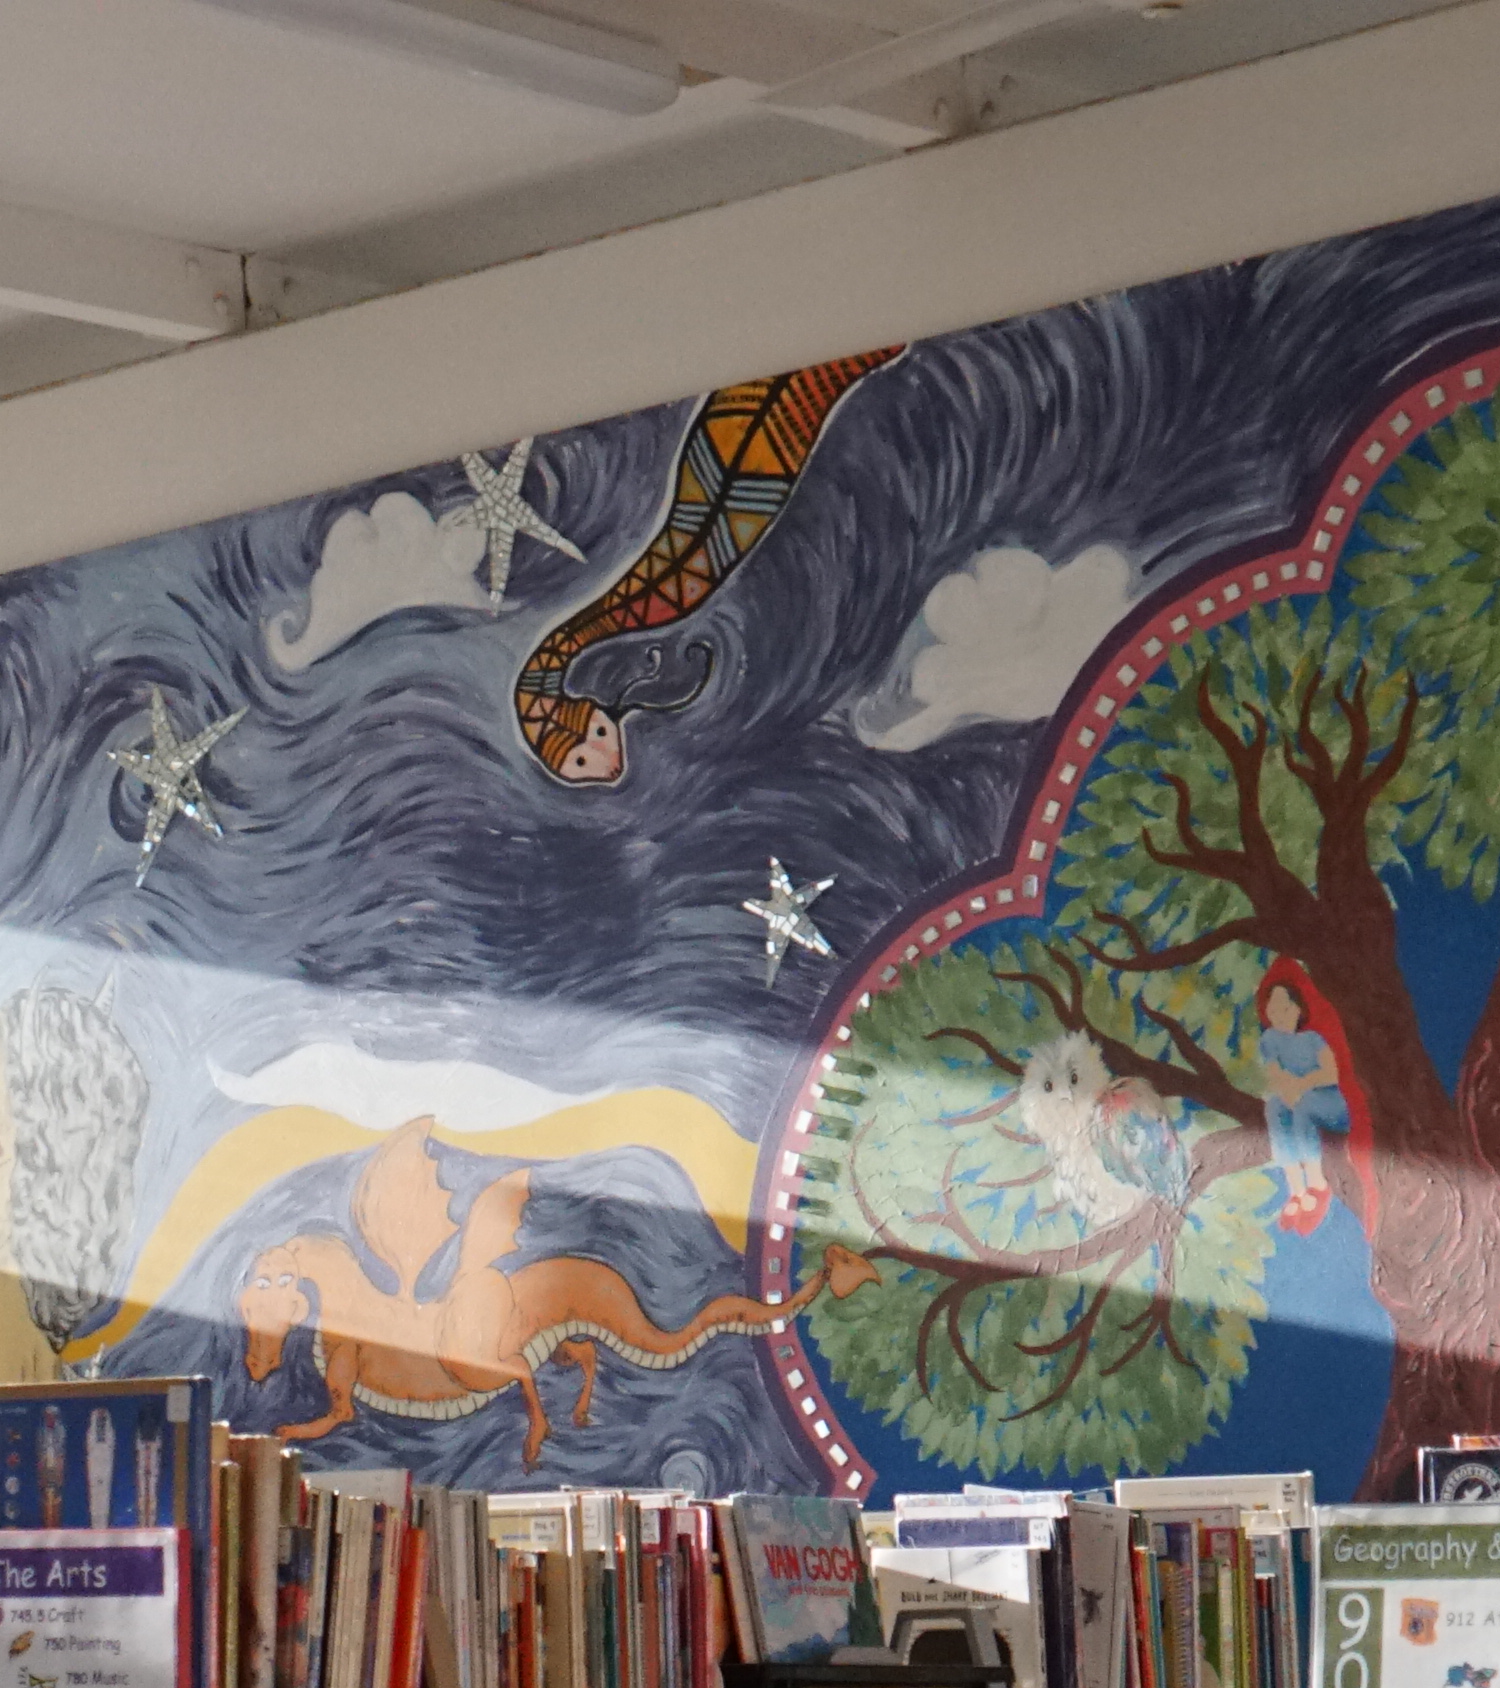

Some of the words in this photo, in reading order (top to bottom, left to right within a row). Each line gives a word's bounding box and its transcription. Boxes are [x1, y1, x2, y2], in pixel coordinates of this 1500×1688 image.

[1334, 1533, 1477, 1570] Geography
[45, 1558, 108, 1589] Arts
[763, 1544, 799, 1581] VAN
[802, 1545, 863, 1584] GOGH
[48, 1607, 85, 1623] Craft
[1446, 1611, 1474, 1628] 912
[69, 1635, 122, 1655] Painting
[66, 1672, 88, 1685] 780
[92, 1671, 130, 1686] Music
